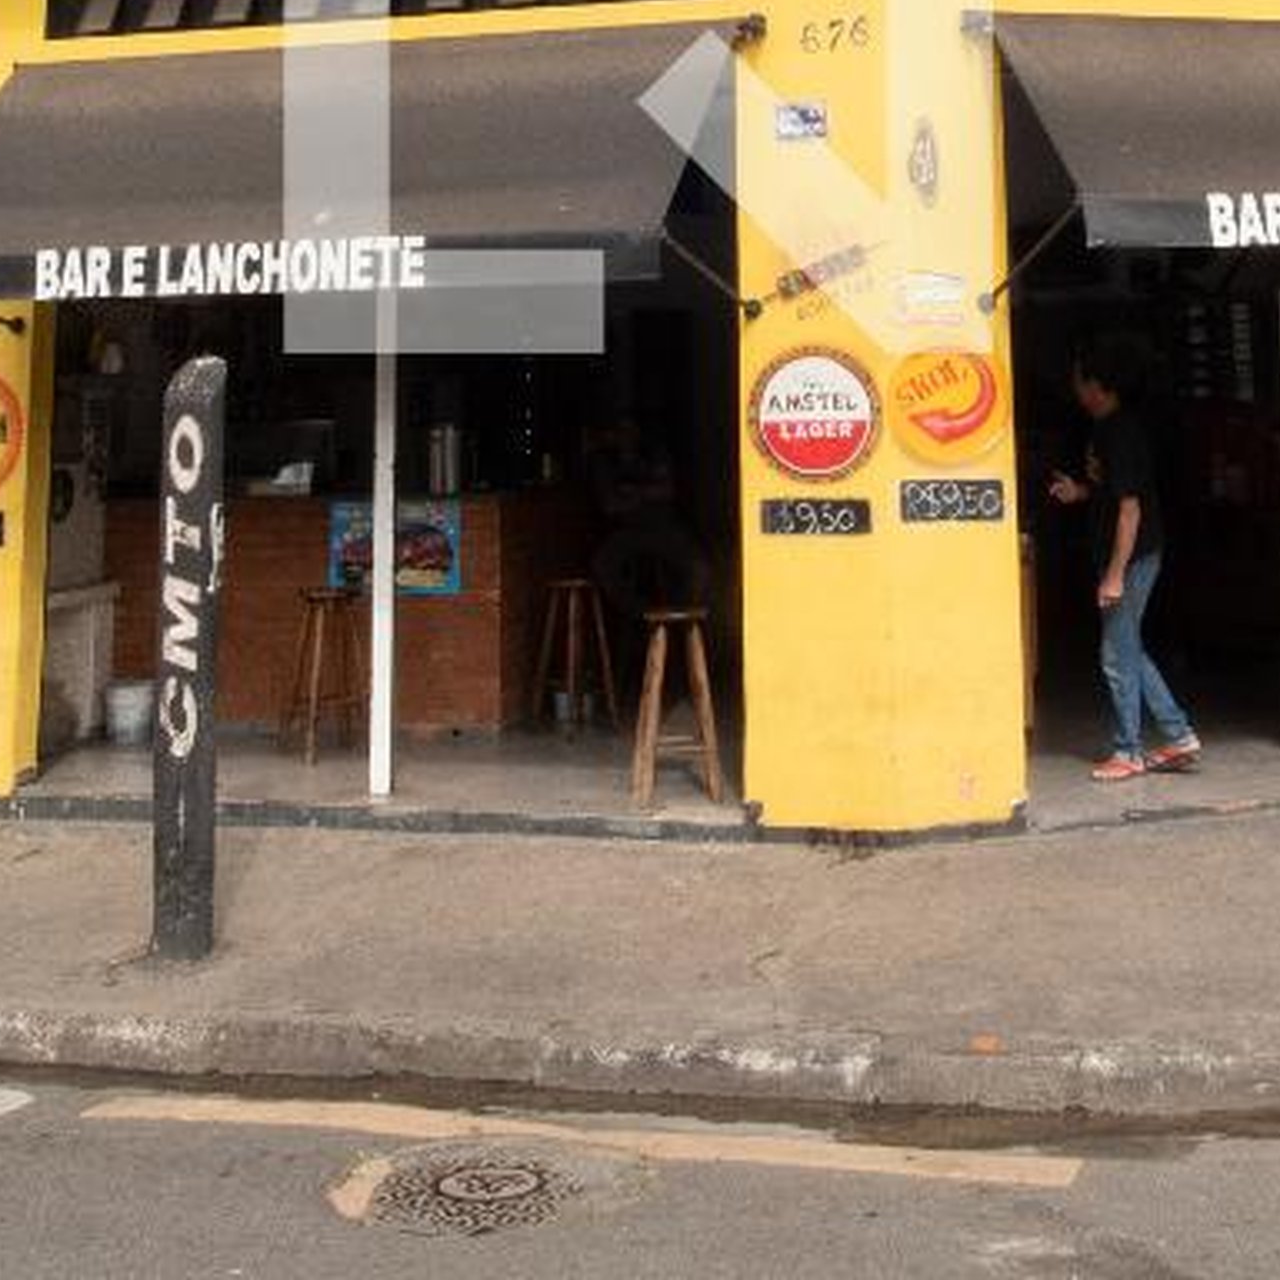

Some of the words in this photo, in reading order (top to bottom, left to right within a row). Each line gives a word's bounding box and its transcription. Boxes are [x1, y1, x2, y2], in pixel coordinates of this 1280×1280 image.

[34, 246, 112, 301] BAR
[121, 245, 149, 297] E
[156, 235, 427, 295] LANCHONETE
[768, 391, 859, 413] AMSTEL
[778, 422, 854, 442] LAGER
